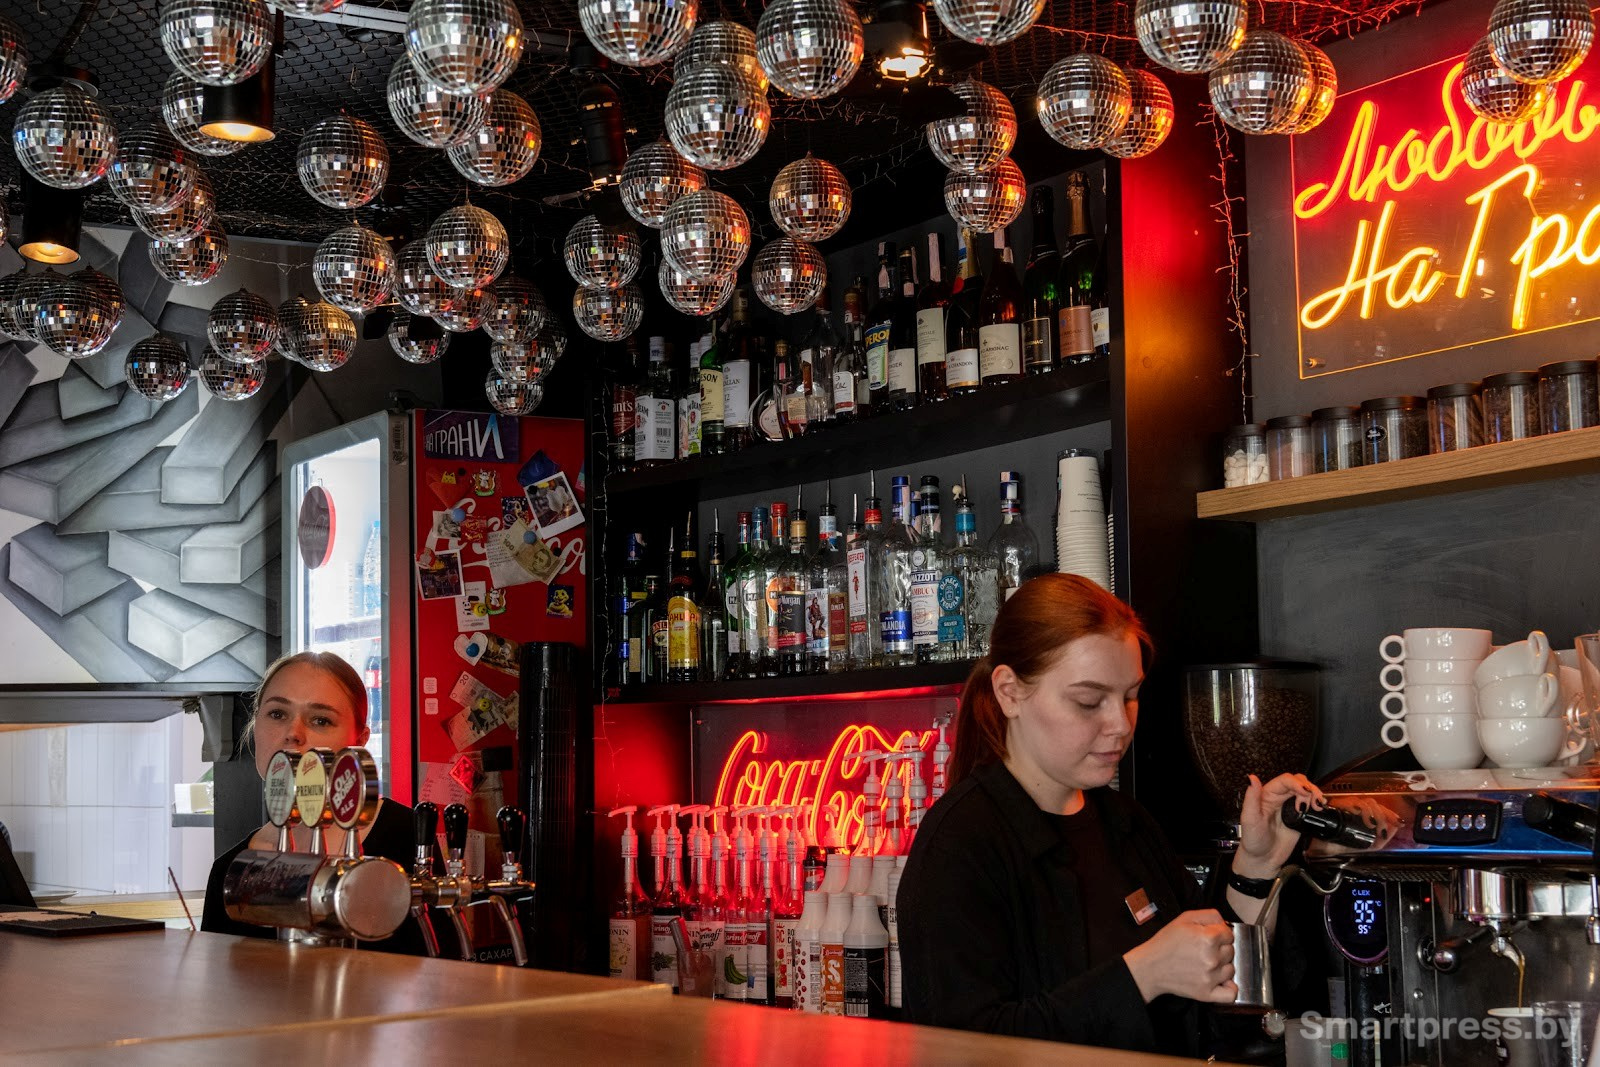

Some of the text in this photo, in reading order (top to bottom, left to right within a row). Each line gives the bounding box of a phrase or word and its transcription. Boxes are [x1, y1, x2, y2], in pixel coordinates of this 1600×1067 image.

[701, 374, 718, 383] ESON
[612, 401, 633, 412] ant's
[882, 621, 906, 631] NLANDIA
[334, 768, 351, 792] OLD
[297, 784, 324, 797] PREMIUM
[332, 772, 357, 810] BOBBY
[713, 724, 938, 858] Coca-Col
[341, 799, 355, 816] ALE
[480, 948, 513, 962] САХАР
